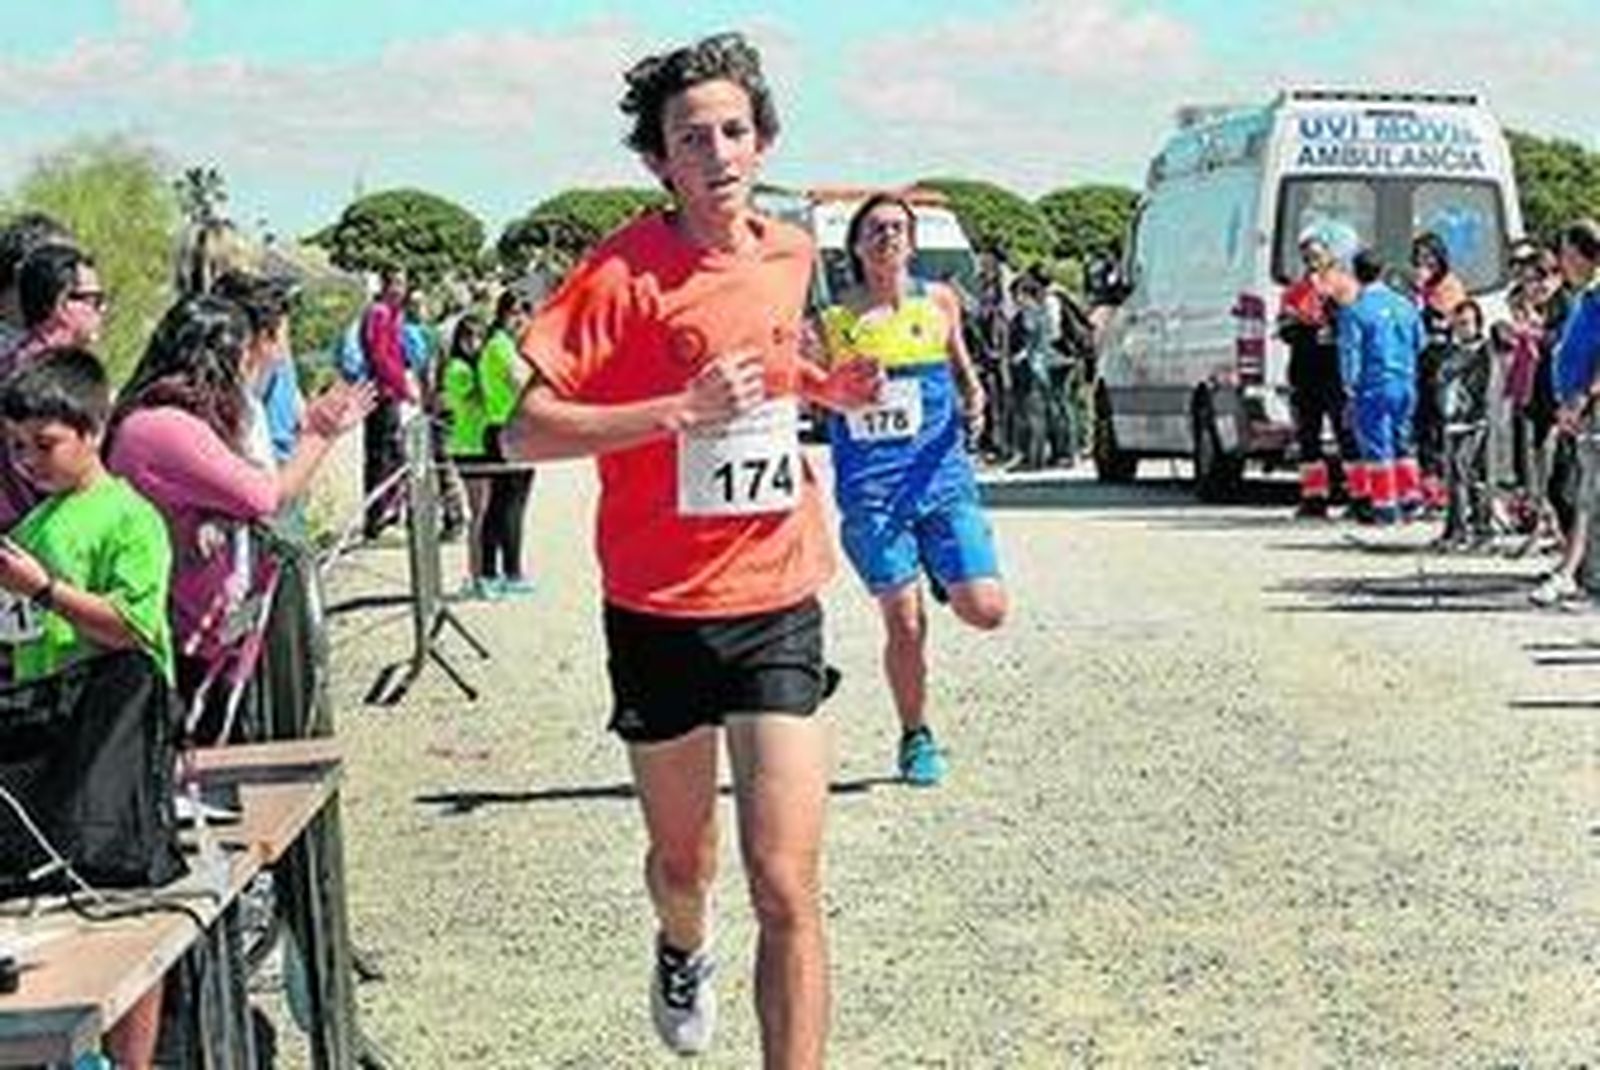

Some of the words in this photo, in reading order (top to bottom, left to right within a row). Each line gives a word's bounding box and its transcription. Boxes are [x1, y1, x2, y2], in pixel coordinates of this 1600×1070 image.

[1299, 117, 1358, 139] UVI
[1297, 146, 1486, 171] AMBULANCIA
[713, 454, 793, 502] 174
